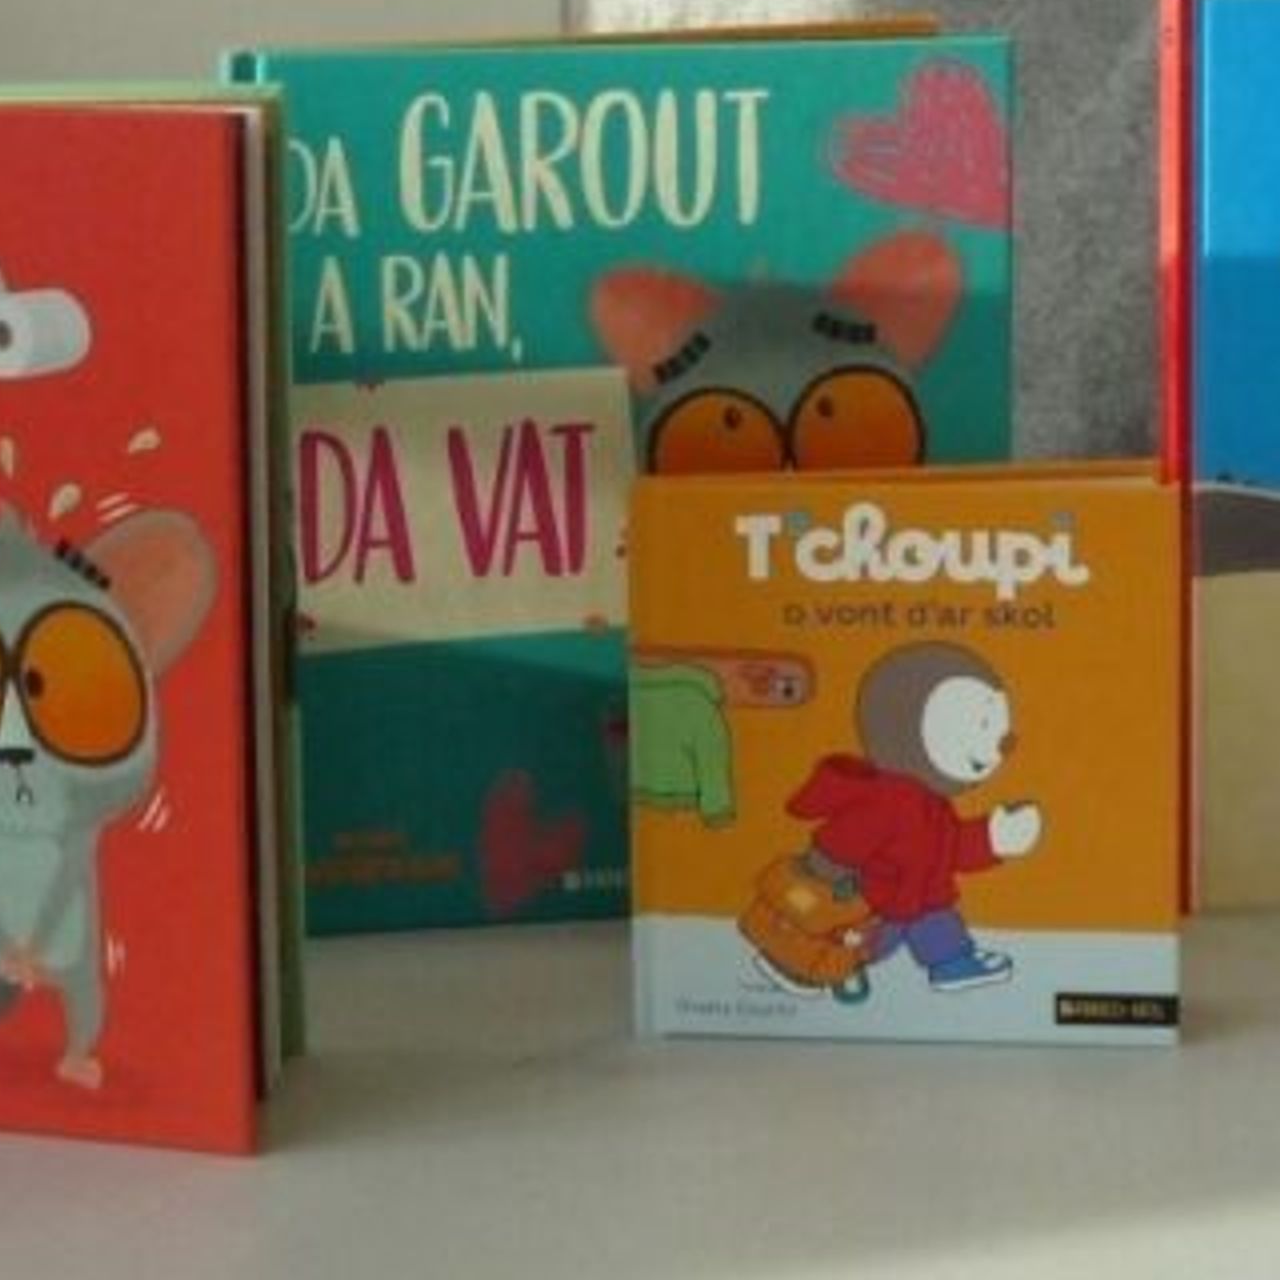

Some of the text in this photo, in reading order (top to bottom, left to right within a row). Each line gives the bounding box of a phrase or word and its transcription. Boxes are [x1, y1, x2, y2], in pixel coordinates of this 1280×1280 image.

[400, 88, 769, 234] GAROUT
[310, 251, 522, 362] A RAN,
[298, 419, 595, 584] DA VAT
[734, 502, 1090, 602] T'choupi
[816, 601, 898, 629] vont
[984, 599, 1057, 629] skol
